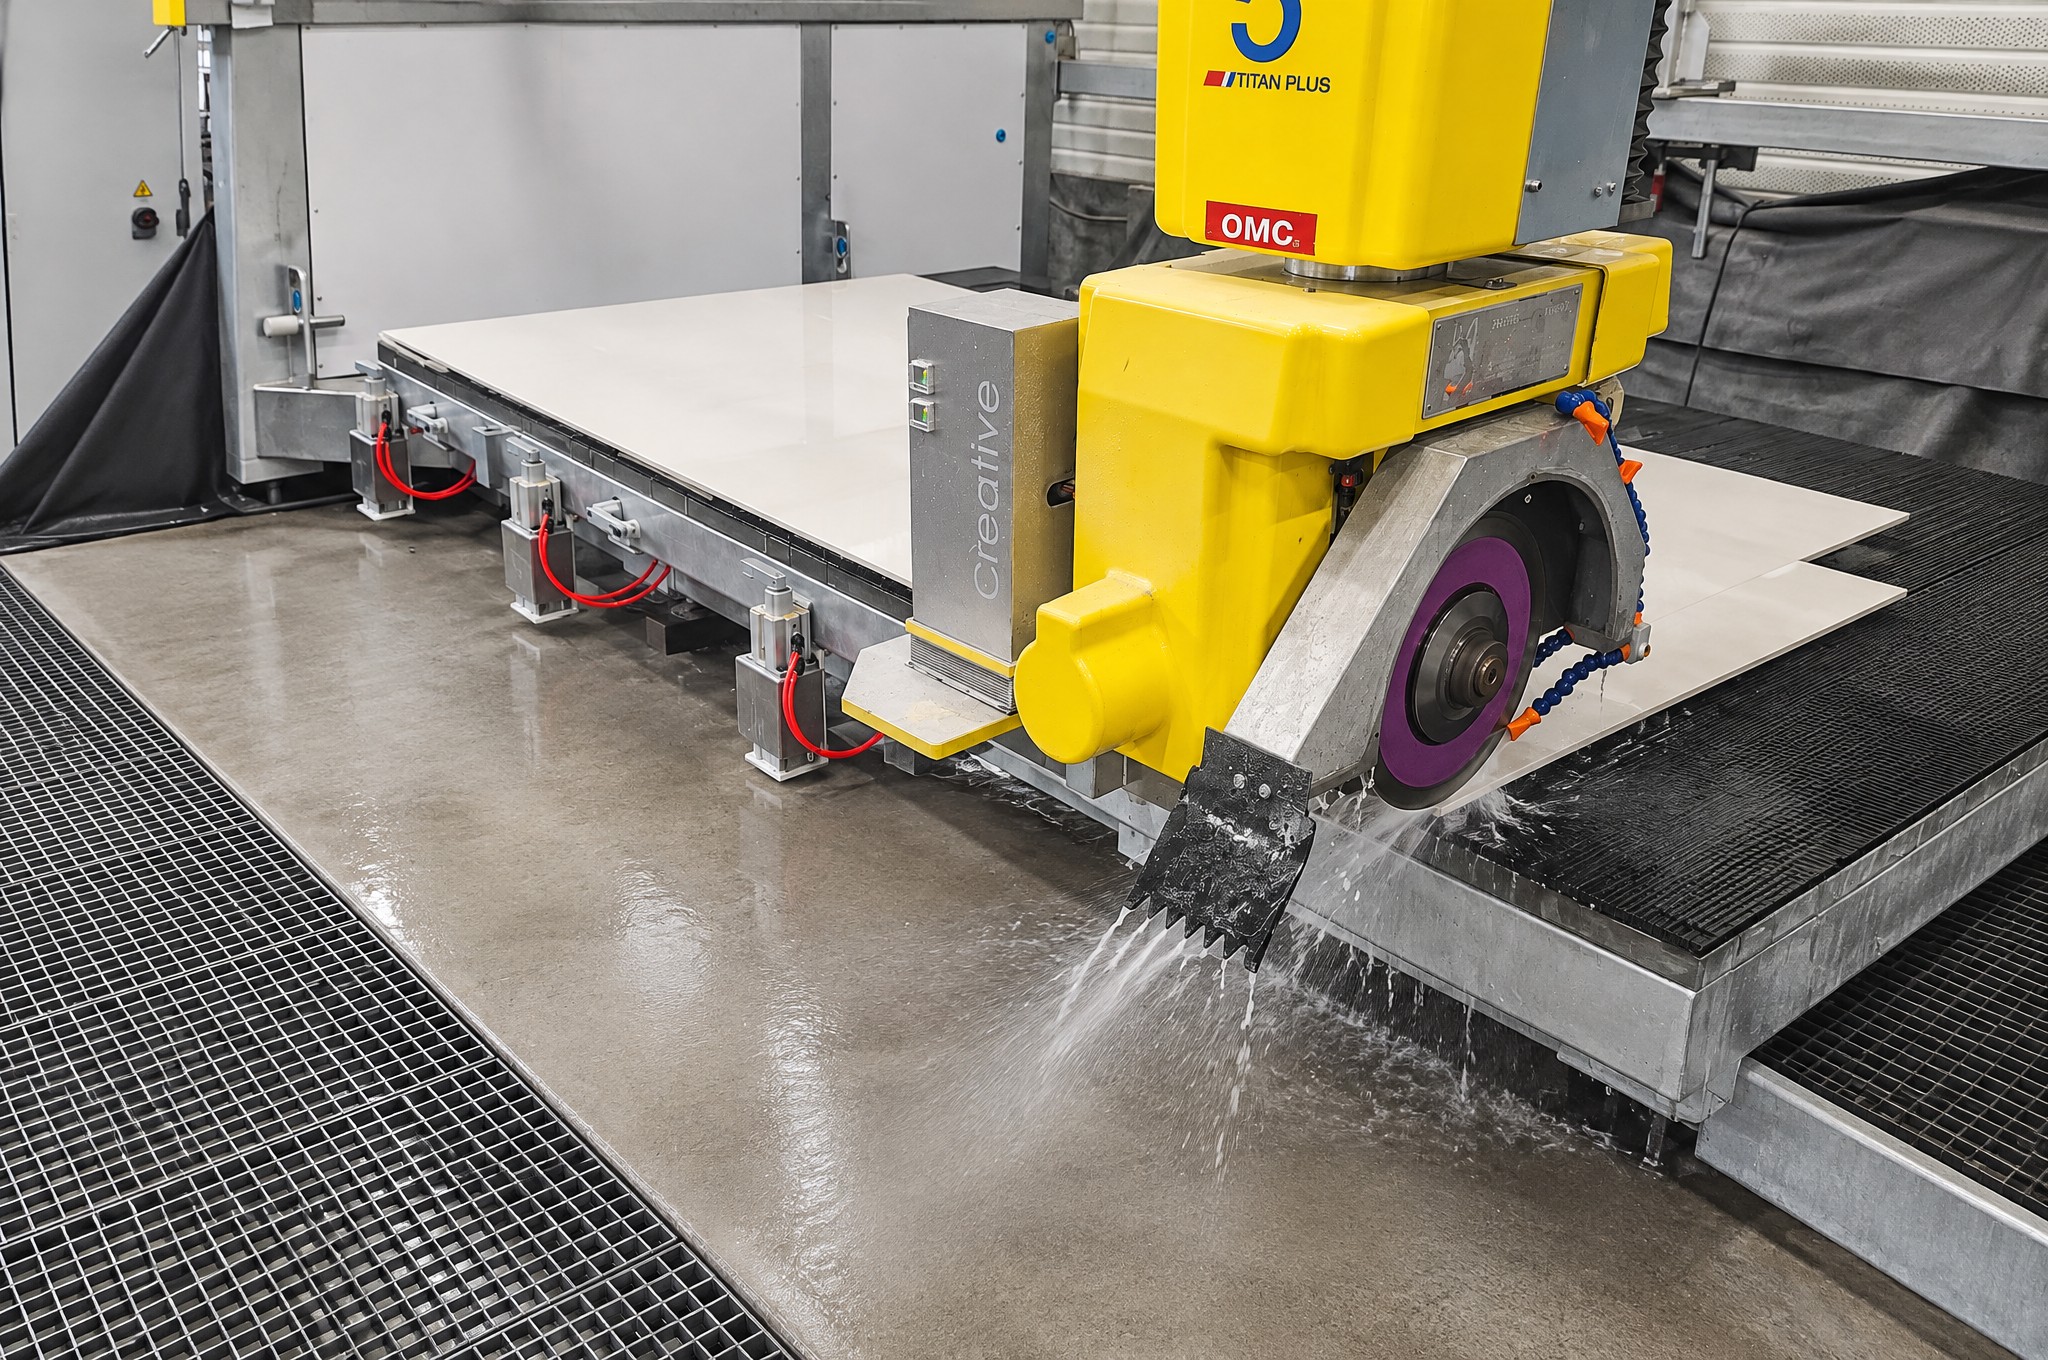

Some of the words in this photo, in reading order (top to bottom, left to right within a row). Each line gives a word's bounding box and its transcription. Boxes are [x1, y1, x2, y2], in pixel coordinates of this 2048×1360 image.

[1237, 72, 1281, 90] TITAN
[1285, 75, 1331, 93] PLUS
[1221, 213, 1293, 246] OMC
[969, 380, 999, 599] Creative
